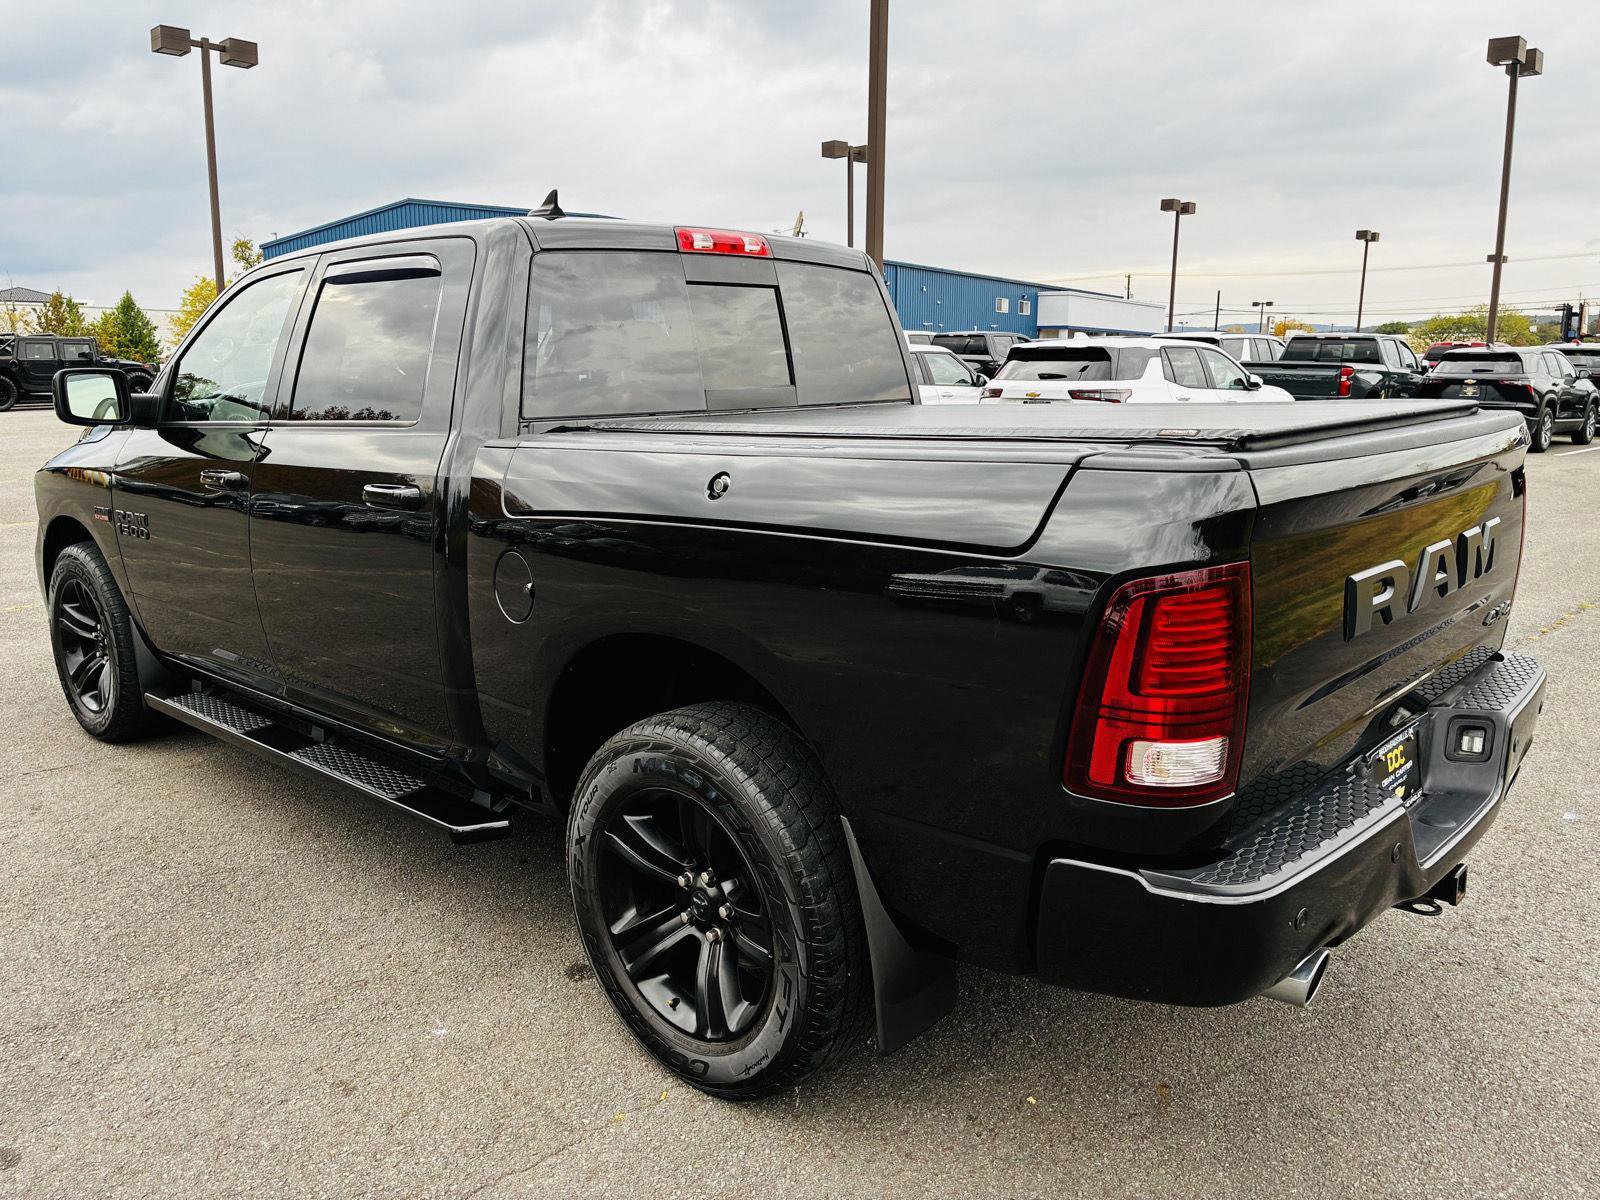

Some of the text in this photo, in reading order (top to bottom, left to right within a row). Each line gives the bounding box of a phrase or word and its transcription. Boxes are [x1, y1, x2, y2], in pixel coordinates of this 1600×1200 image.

[115, 509, 149, 527] RAM
[117, 522, 150, 540] 1500
[1344, 516, 1501, 642] RAM
[580, 785, 599, 820] TOUR
